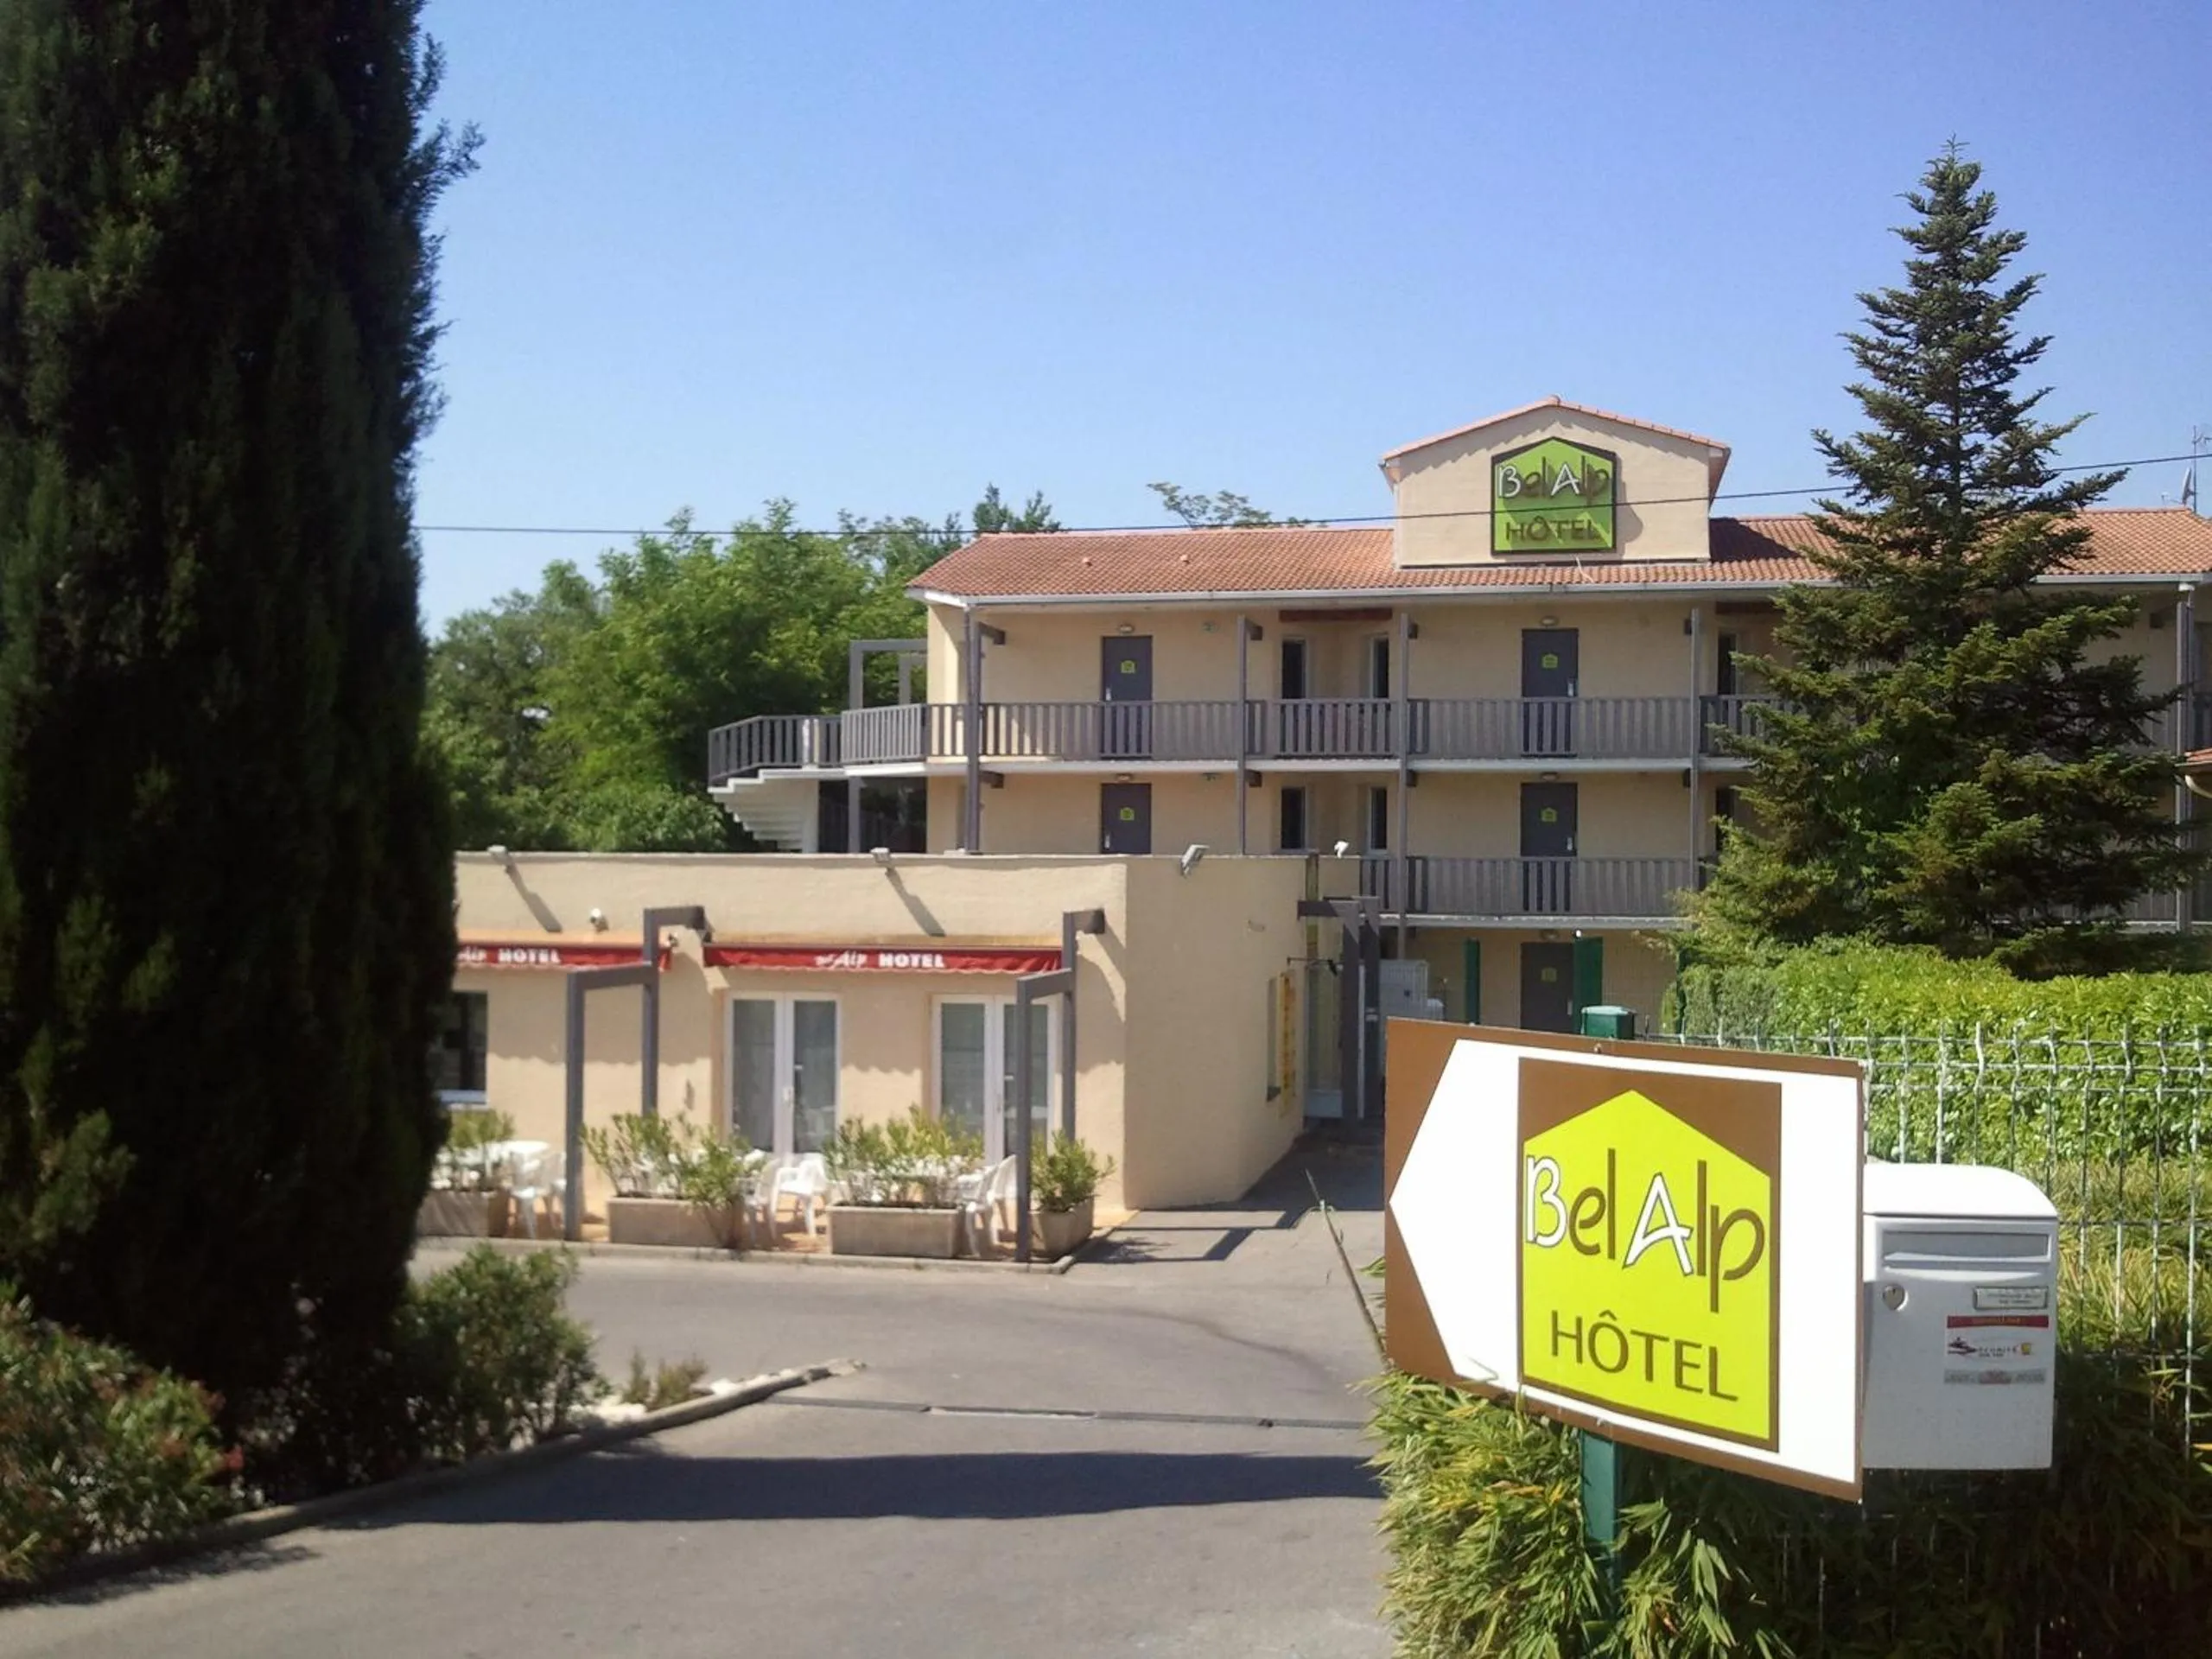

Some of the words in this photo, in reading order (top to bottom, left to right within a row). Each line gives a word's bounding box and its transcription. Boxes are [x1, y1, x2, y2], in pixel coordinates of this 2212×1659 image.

[1506, 517, 1604, 542] HÔTEL
[499, 948, 561, 963] HOTEL
[879, 952, 945, 968] HOTEL
[1552, 1310, 1738, 1402] HÔTEL
